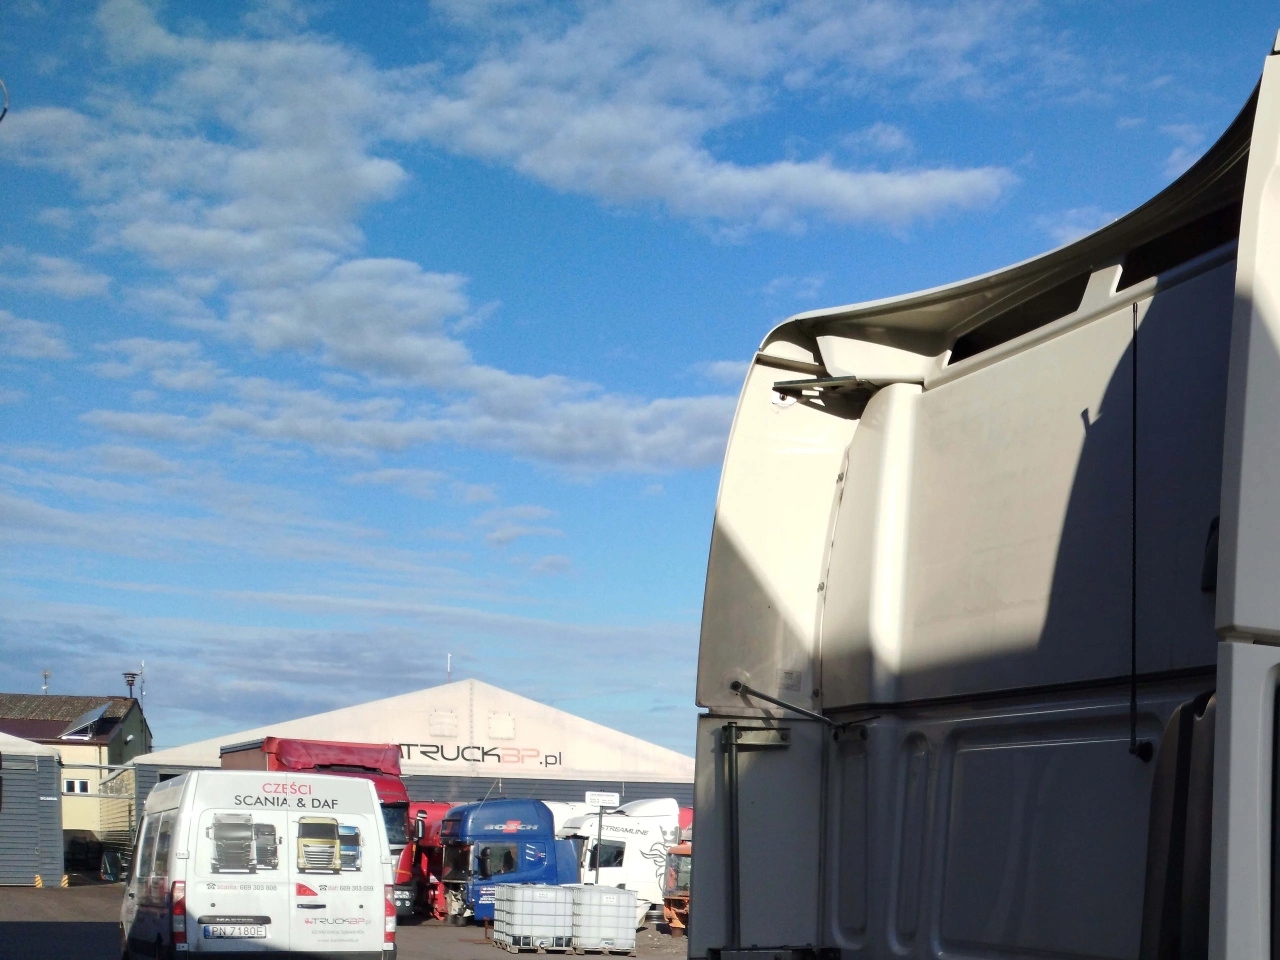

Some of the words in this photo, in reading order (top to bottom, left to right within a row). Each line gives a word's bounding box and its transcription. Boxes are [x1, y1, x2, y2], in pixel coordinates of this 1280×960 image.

[399, 743, 562, 768] TRUCKBP.pl
[262, 781, 312, 796] CZĘŚCI
[234, 794, 291, 808] SCANIA
[296, 798, 307, 809] &
[311, 798, 339, 810] DAF
[484, 823, 539, 831] BOSCH
[601, 824, 650, 836] STREAMLINE
[211, 926, 227, 936] PN
